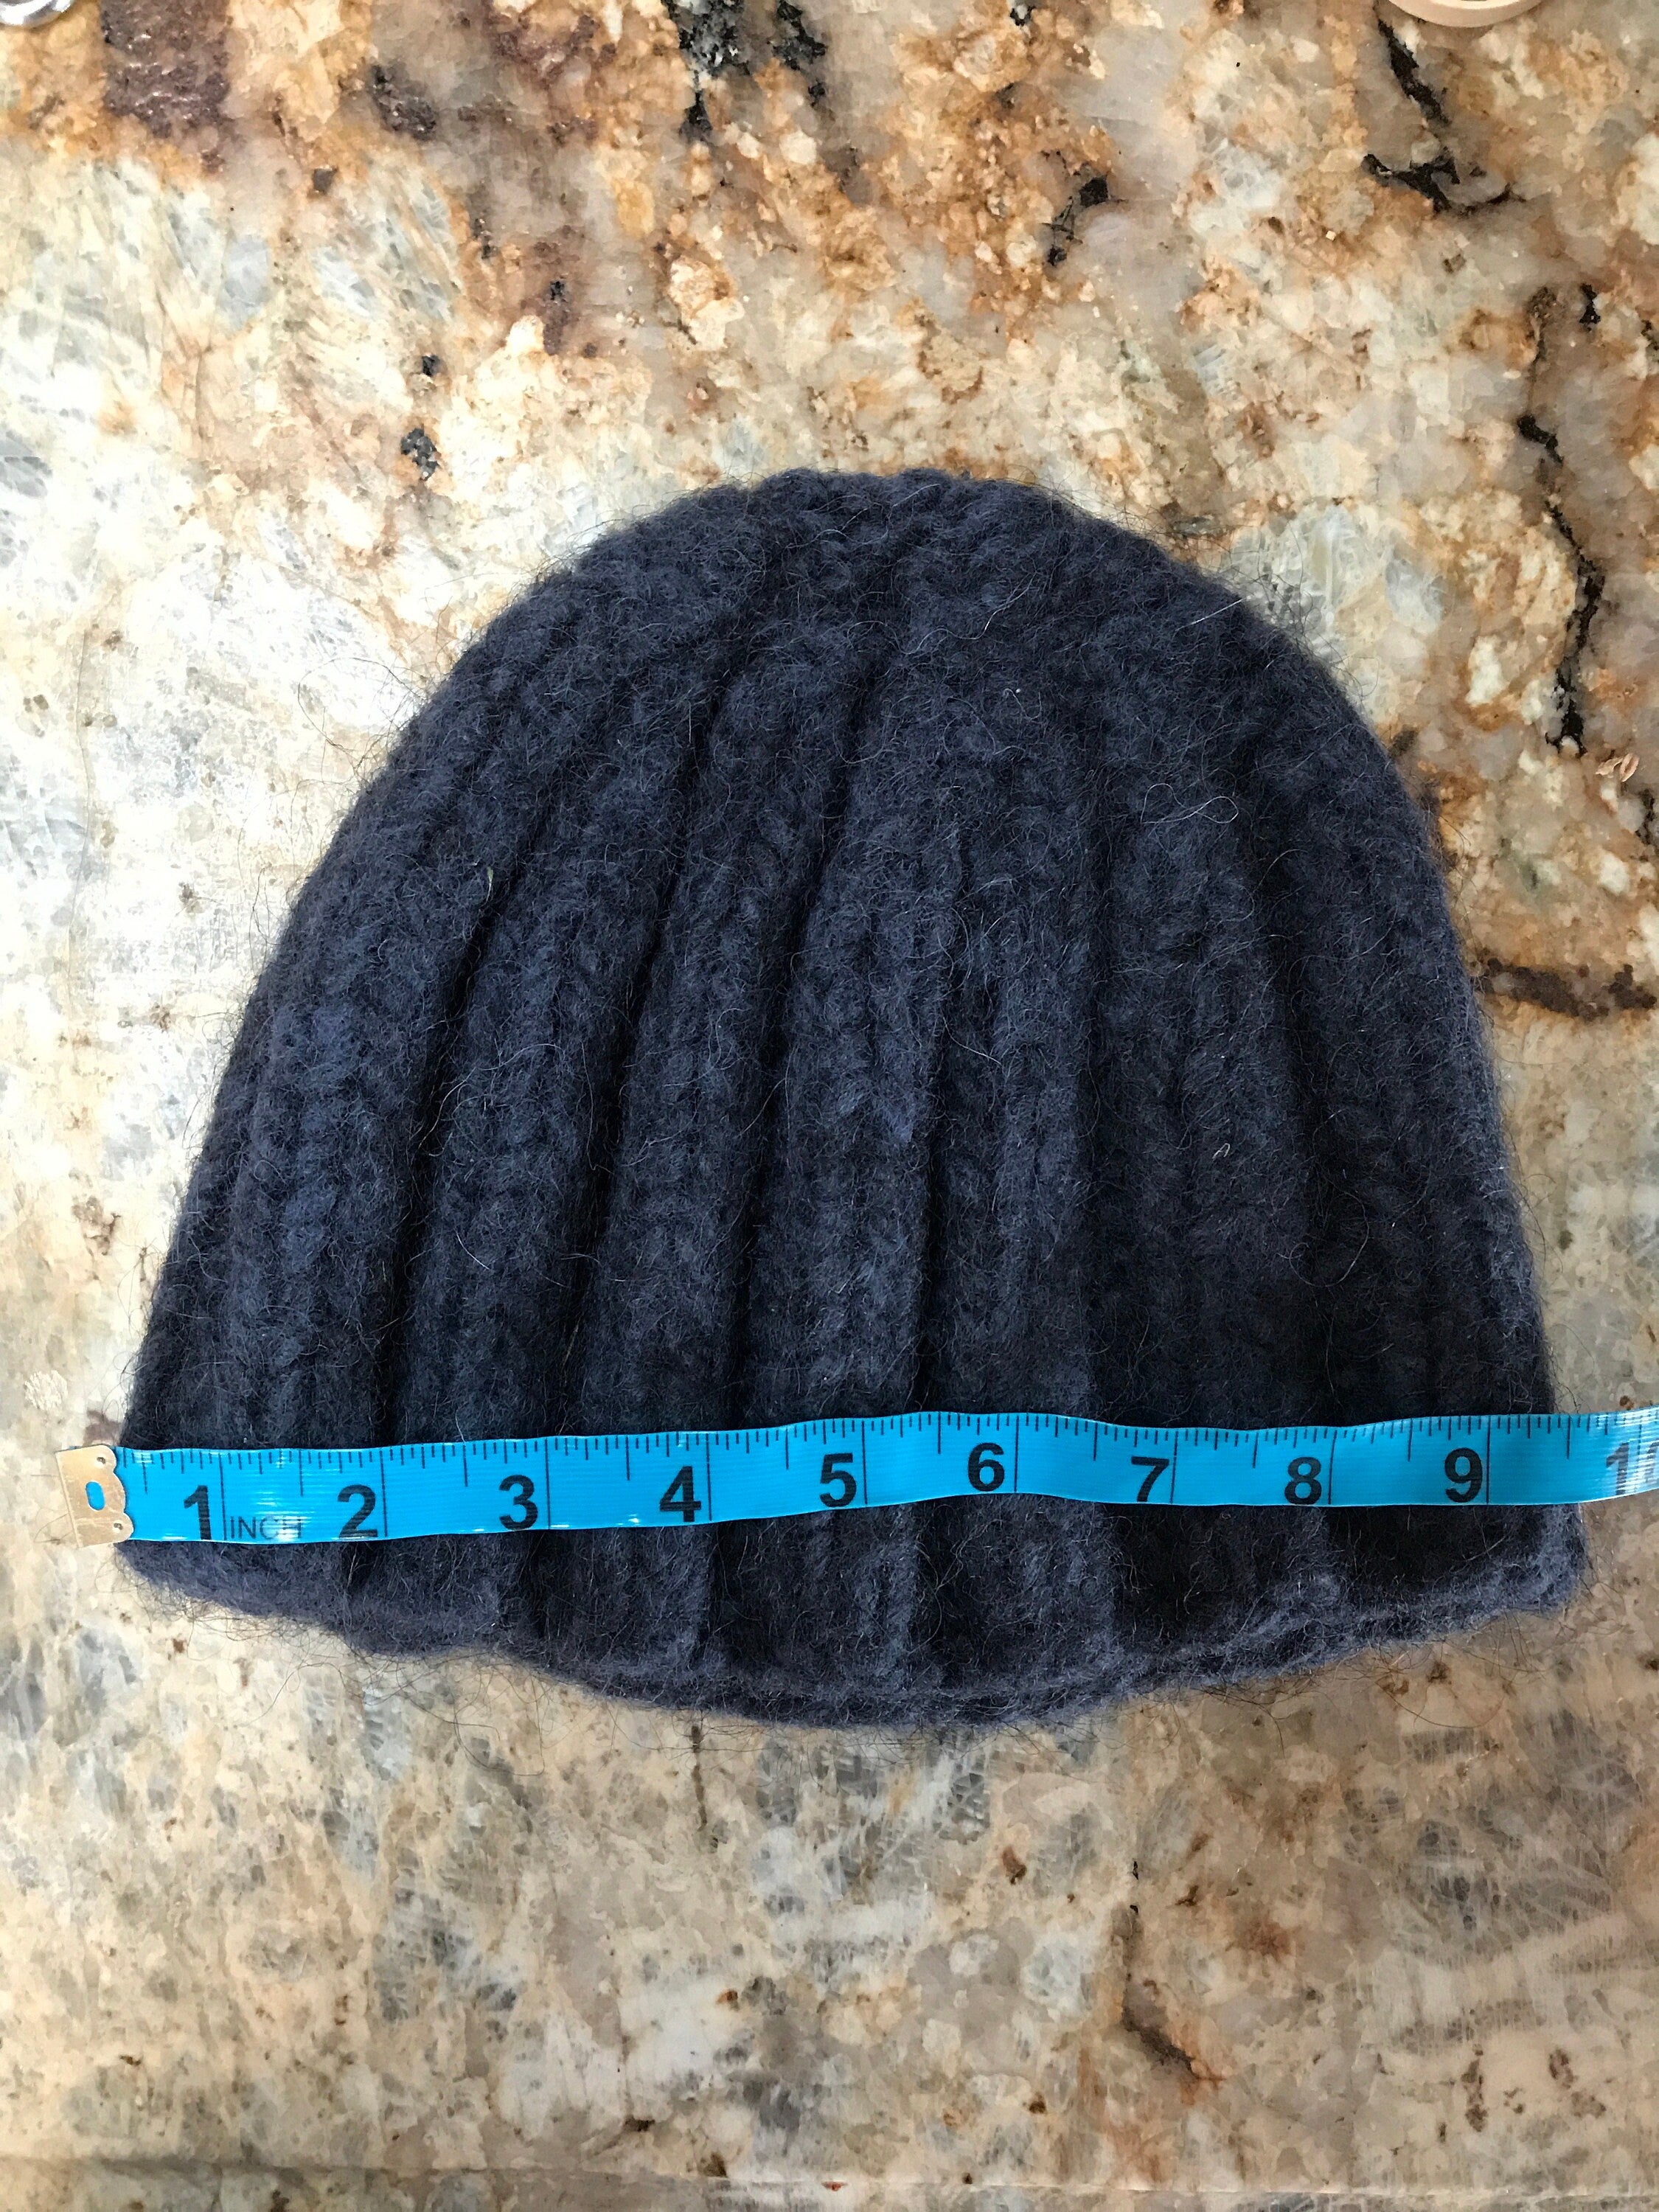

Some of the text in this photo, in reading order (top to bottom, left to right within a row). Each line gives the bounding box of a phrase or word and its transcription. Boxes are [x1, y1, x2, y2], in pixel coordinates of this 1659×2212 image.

[184, 1485, 212, 1540] 1
[230, 1515, 302, 1540] INCH
[338, 1484, 378, 1538] 2
[498, 1475, 538, 1530] 3
[659, 1466, 701, 1522] 4
[819, 1453, 857, 1507] 5
[968, 1442, 1005, 1492] 6
[1131, 1456, 1169, 1502] 7
[1284, 1457, 1322, 1505] 8
[1444, 1447, 1483, 1503] 9
